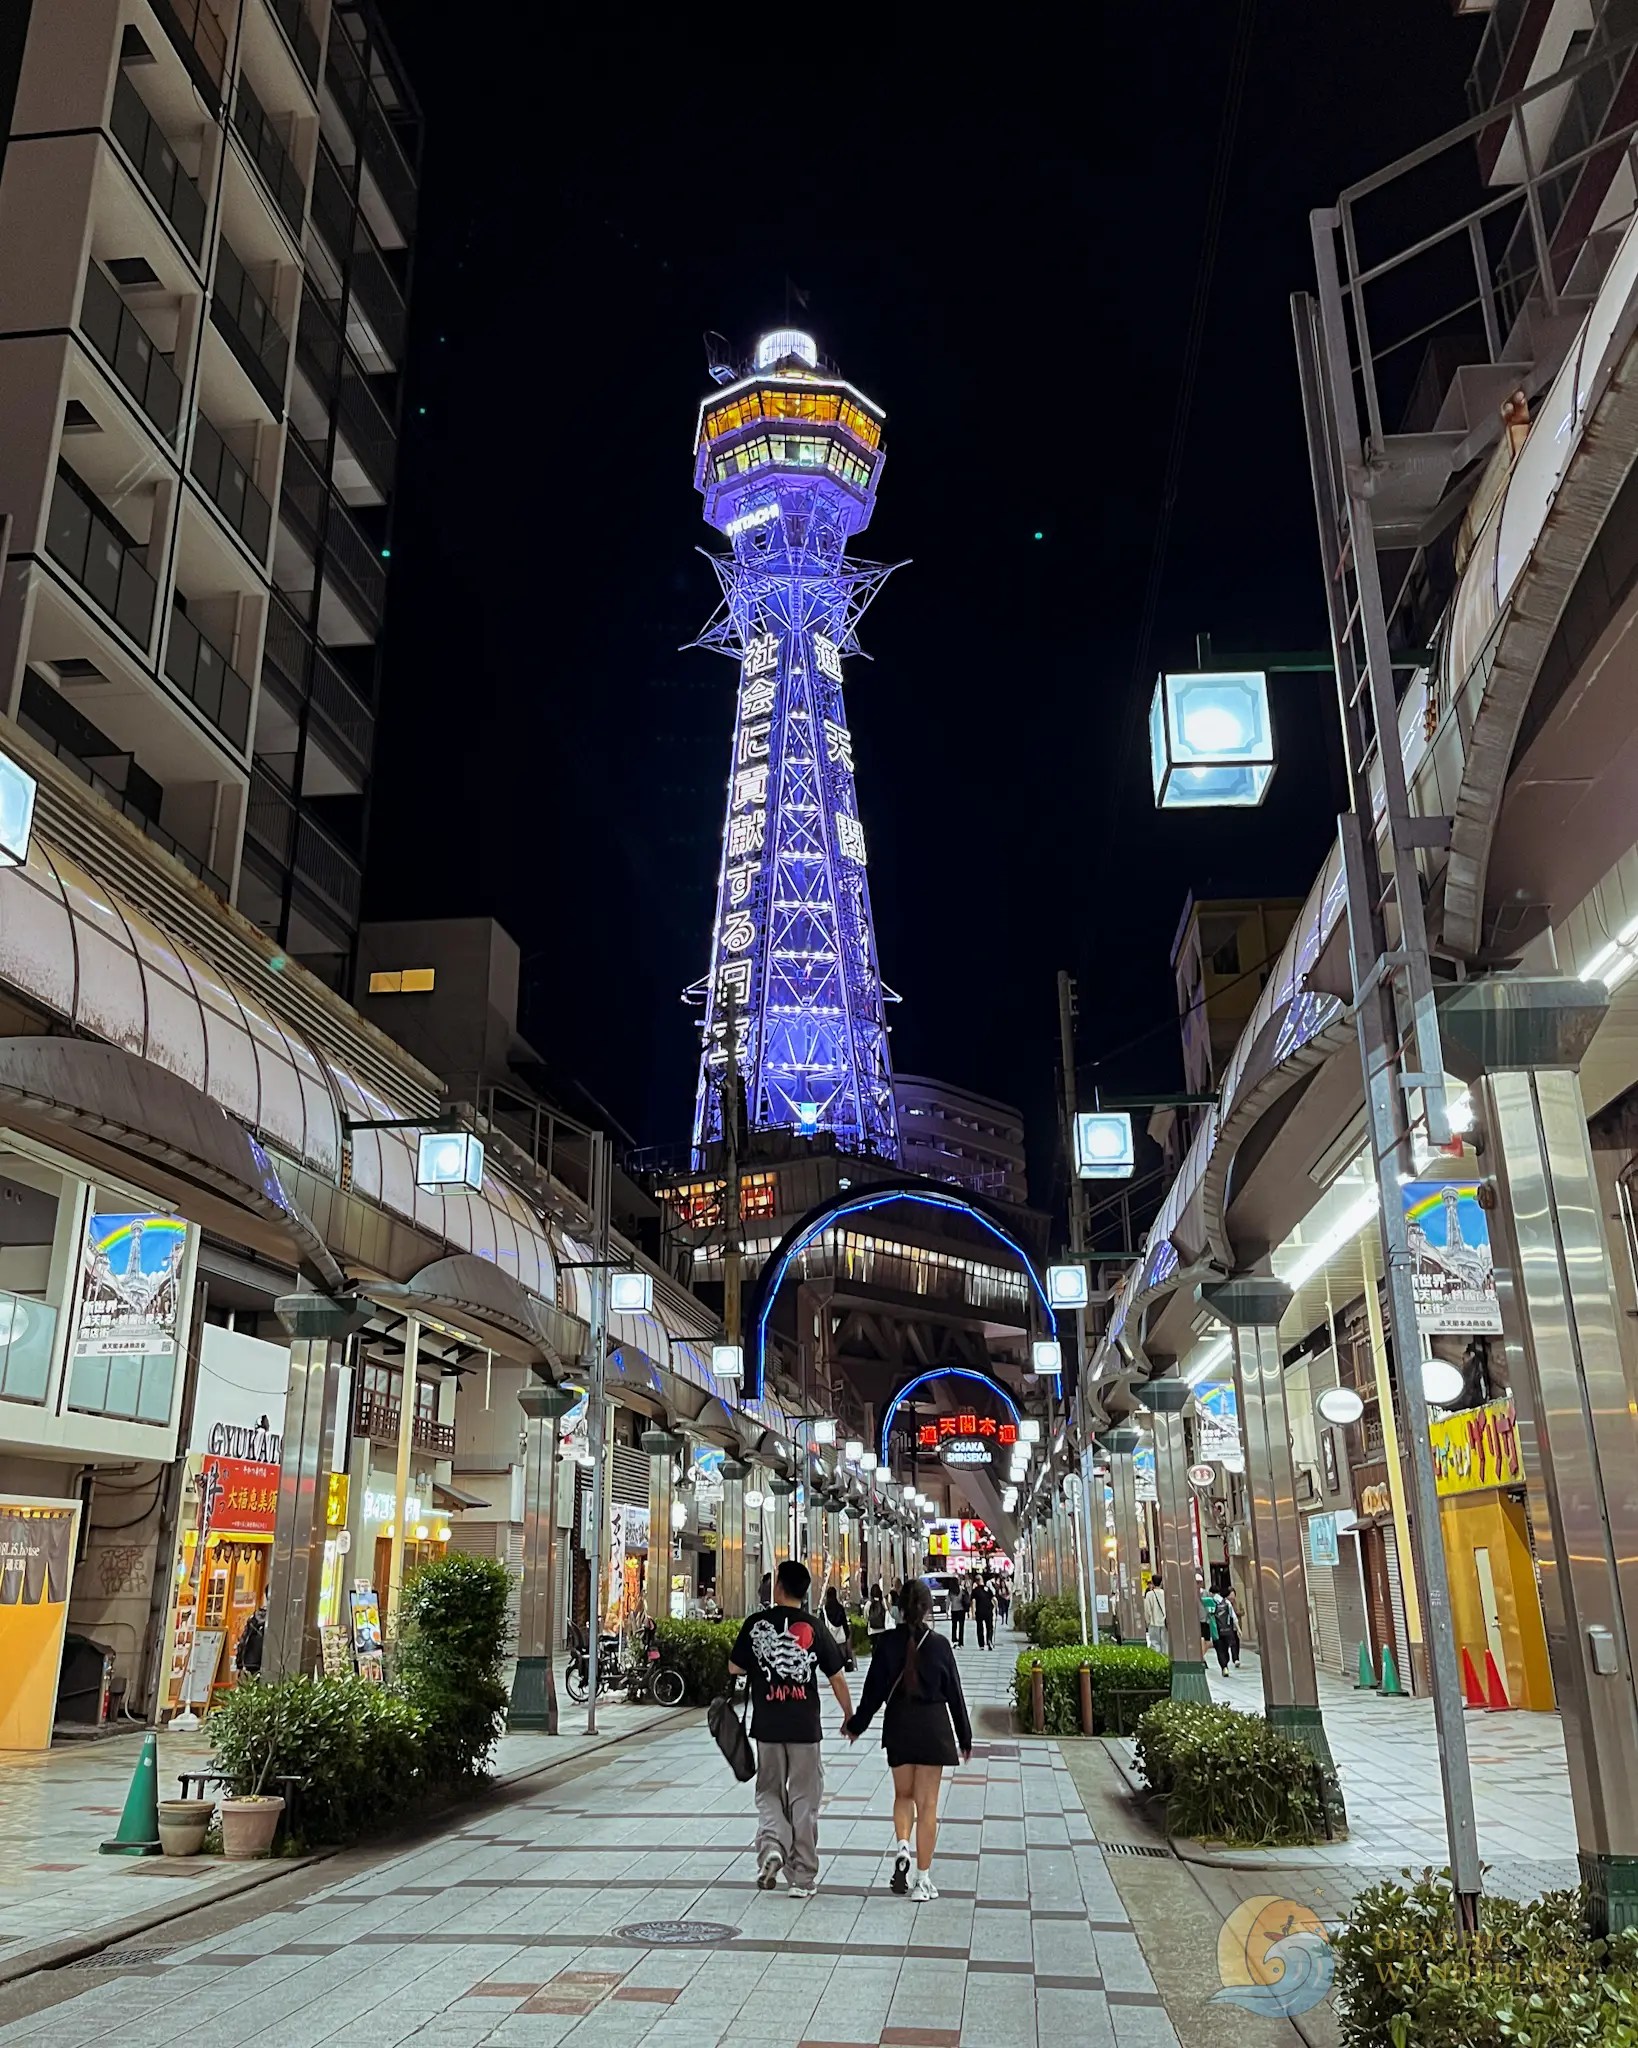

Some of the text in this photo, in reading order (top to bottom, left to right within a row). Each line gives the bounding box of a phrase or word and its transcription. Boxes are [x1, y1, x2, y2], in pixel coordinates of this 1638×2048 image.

[726, 503, 779, 537] HITACHI
[814, 632, 867, 867] 通天閣
[919, 1414, 1017, 1445] 通天閣本通
[947, 1452, 992, 1463] SHINSEKAI
[953, 1442, 985, 1453] OSAKA
[766, 1684, 807, 1702] JAPAN
